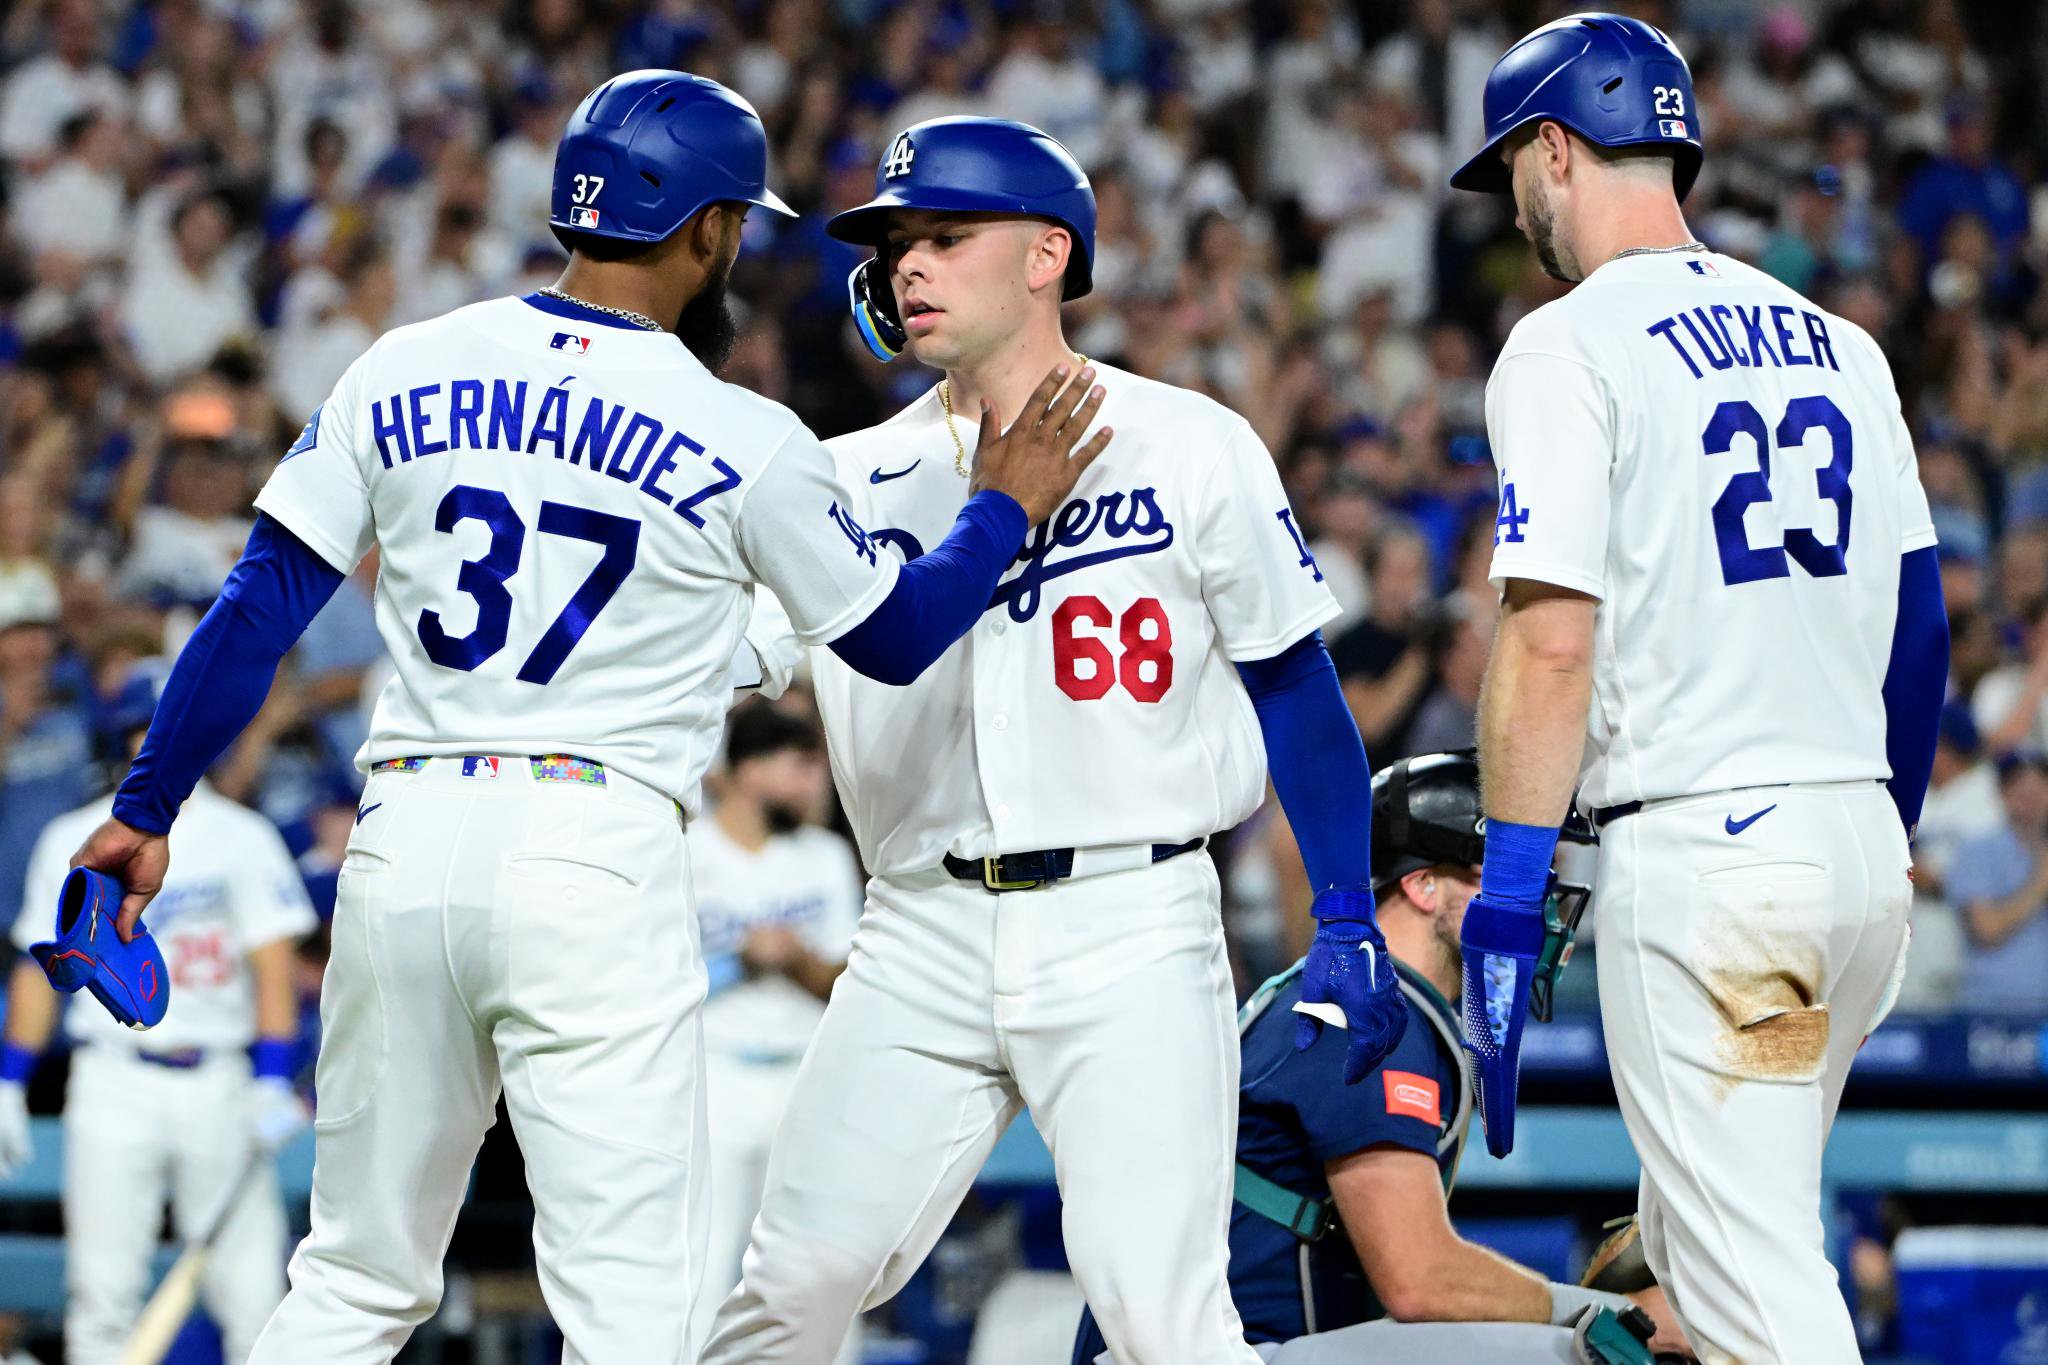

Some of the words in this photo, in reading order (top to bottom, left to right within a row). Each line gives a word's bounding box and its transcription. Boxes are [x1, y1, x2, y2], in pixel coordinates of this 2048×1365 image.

[1653, 86, 1685, 117] 23
[571, 173, 605, 205] 37
[1646, 304, 1841, 380] TUCKER
[371, 375, 743, 530] HERNÁNDEZ
[1701, 394, 1853, 586] 23
[417, 484, 642, 686] 37
[1051, 595, 1174, 703] 68
